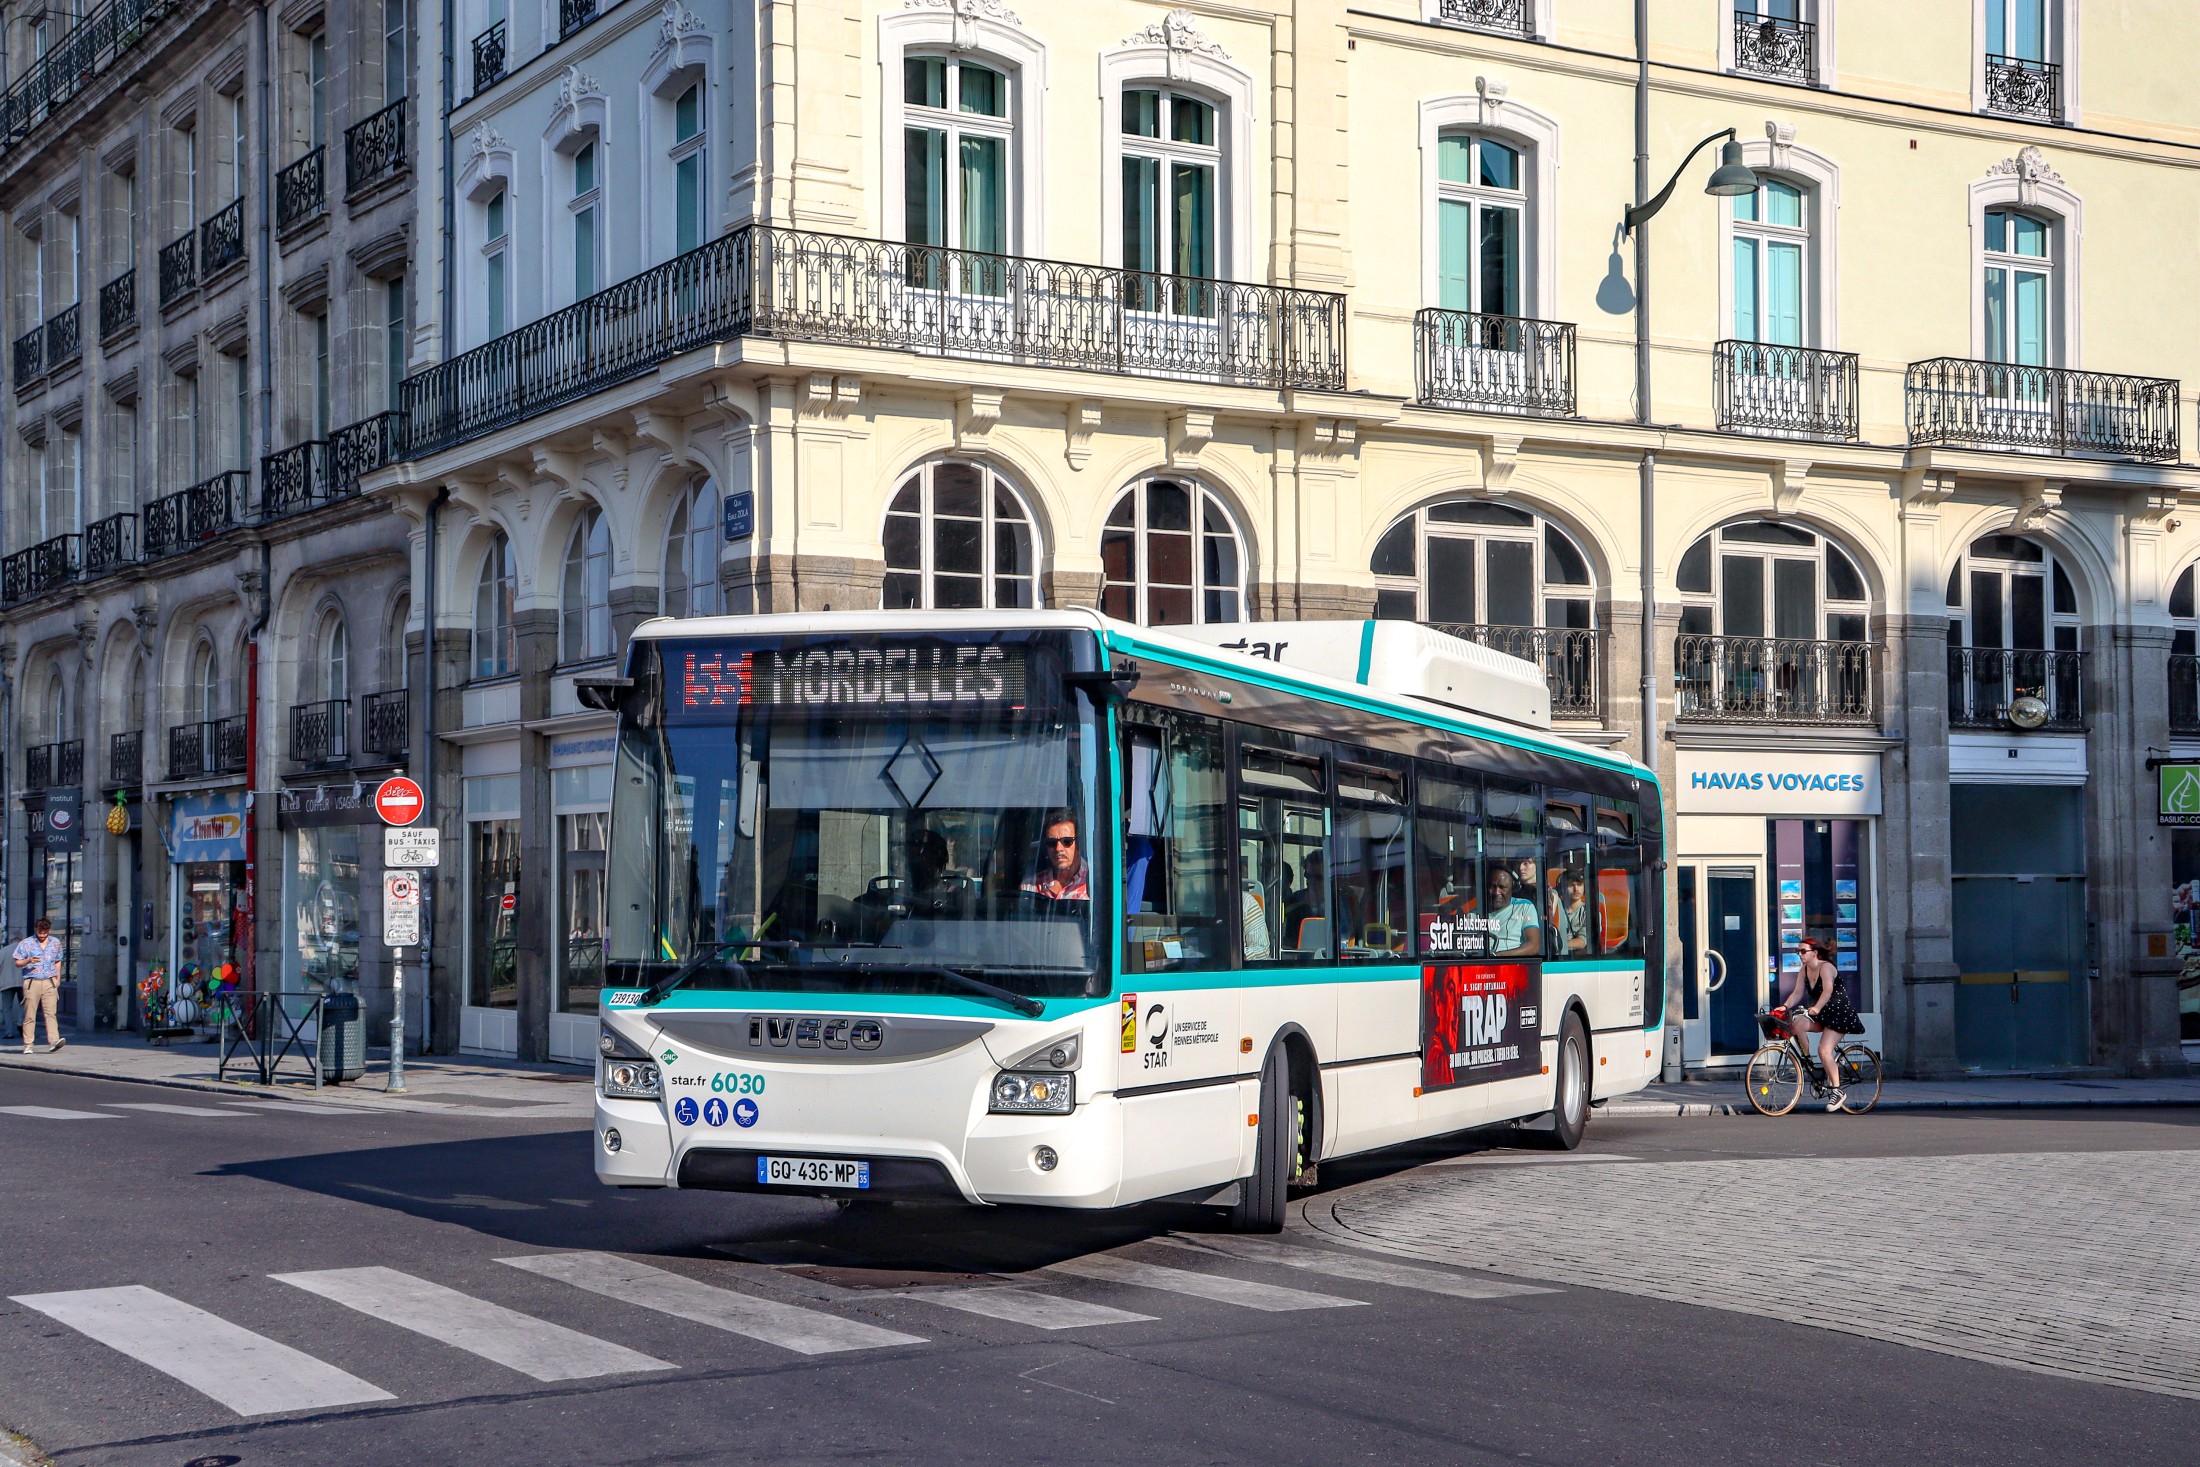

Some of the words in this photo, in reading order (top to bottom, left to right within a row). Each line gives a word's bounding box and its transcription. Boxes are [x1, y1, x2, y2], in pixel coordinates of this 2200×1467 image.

[1218, 637, 1288, 662] tar
[773, 646, 1004, 704] MORDELLES
[1171, 683, 1216, 698] URBANWAY
[1692, 772, 1764, 790] HAVAS
[1768, 773, 1864, 791] VOYAGES
[306, 799, 329, 812] COIFFEUR
[335, 796, 360, 809] VISAGISTE
[1456, 915, 1463, 930] Le
[1464, 914, 1474, 930] bus
[1475, 915, 1487, 930] chez
[1488, 919, 1500, 931] vous
[1430, 915, 1454, 950] star
[1457, 936, 1463, 949] et
[1464, 935, 1484, 952] partout
[1470, 983, 1482, 991] NIGHT
[611, 993, 640, 1004] 239130
[1175, 1023, 1181, 1032] UN
[1182, 1022, 1200, 1031] SERVICE
[1201, 1021, 1207, 1030] DE
[1462, 994, 1507, 1046] TRAP
[749, 1017, 883, 1050] IVECO
[1174, 1036, 1192, 1046] RENNES
[1193, 1032, 1219, 1044] MÉTROPOLE
[1144, 1052, 1167, 1069] STAR
[671, 1076, 706, 1086] star.fr
[711, 1072, 765, 1095] 6030
[771, 1161, 856, 1182] GQ-436-MP
[860, 1175, 867, 1184] 35
